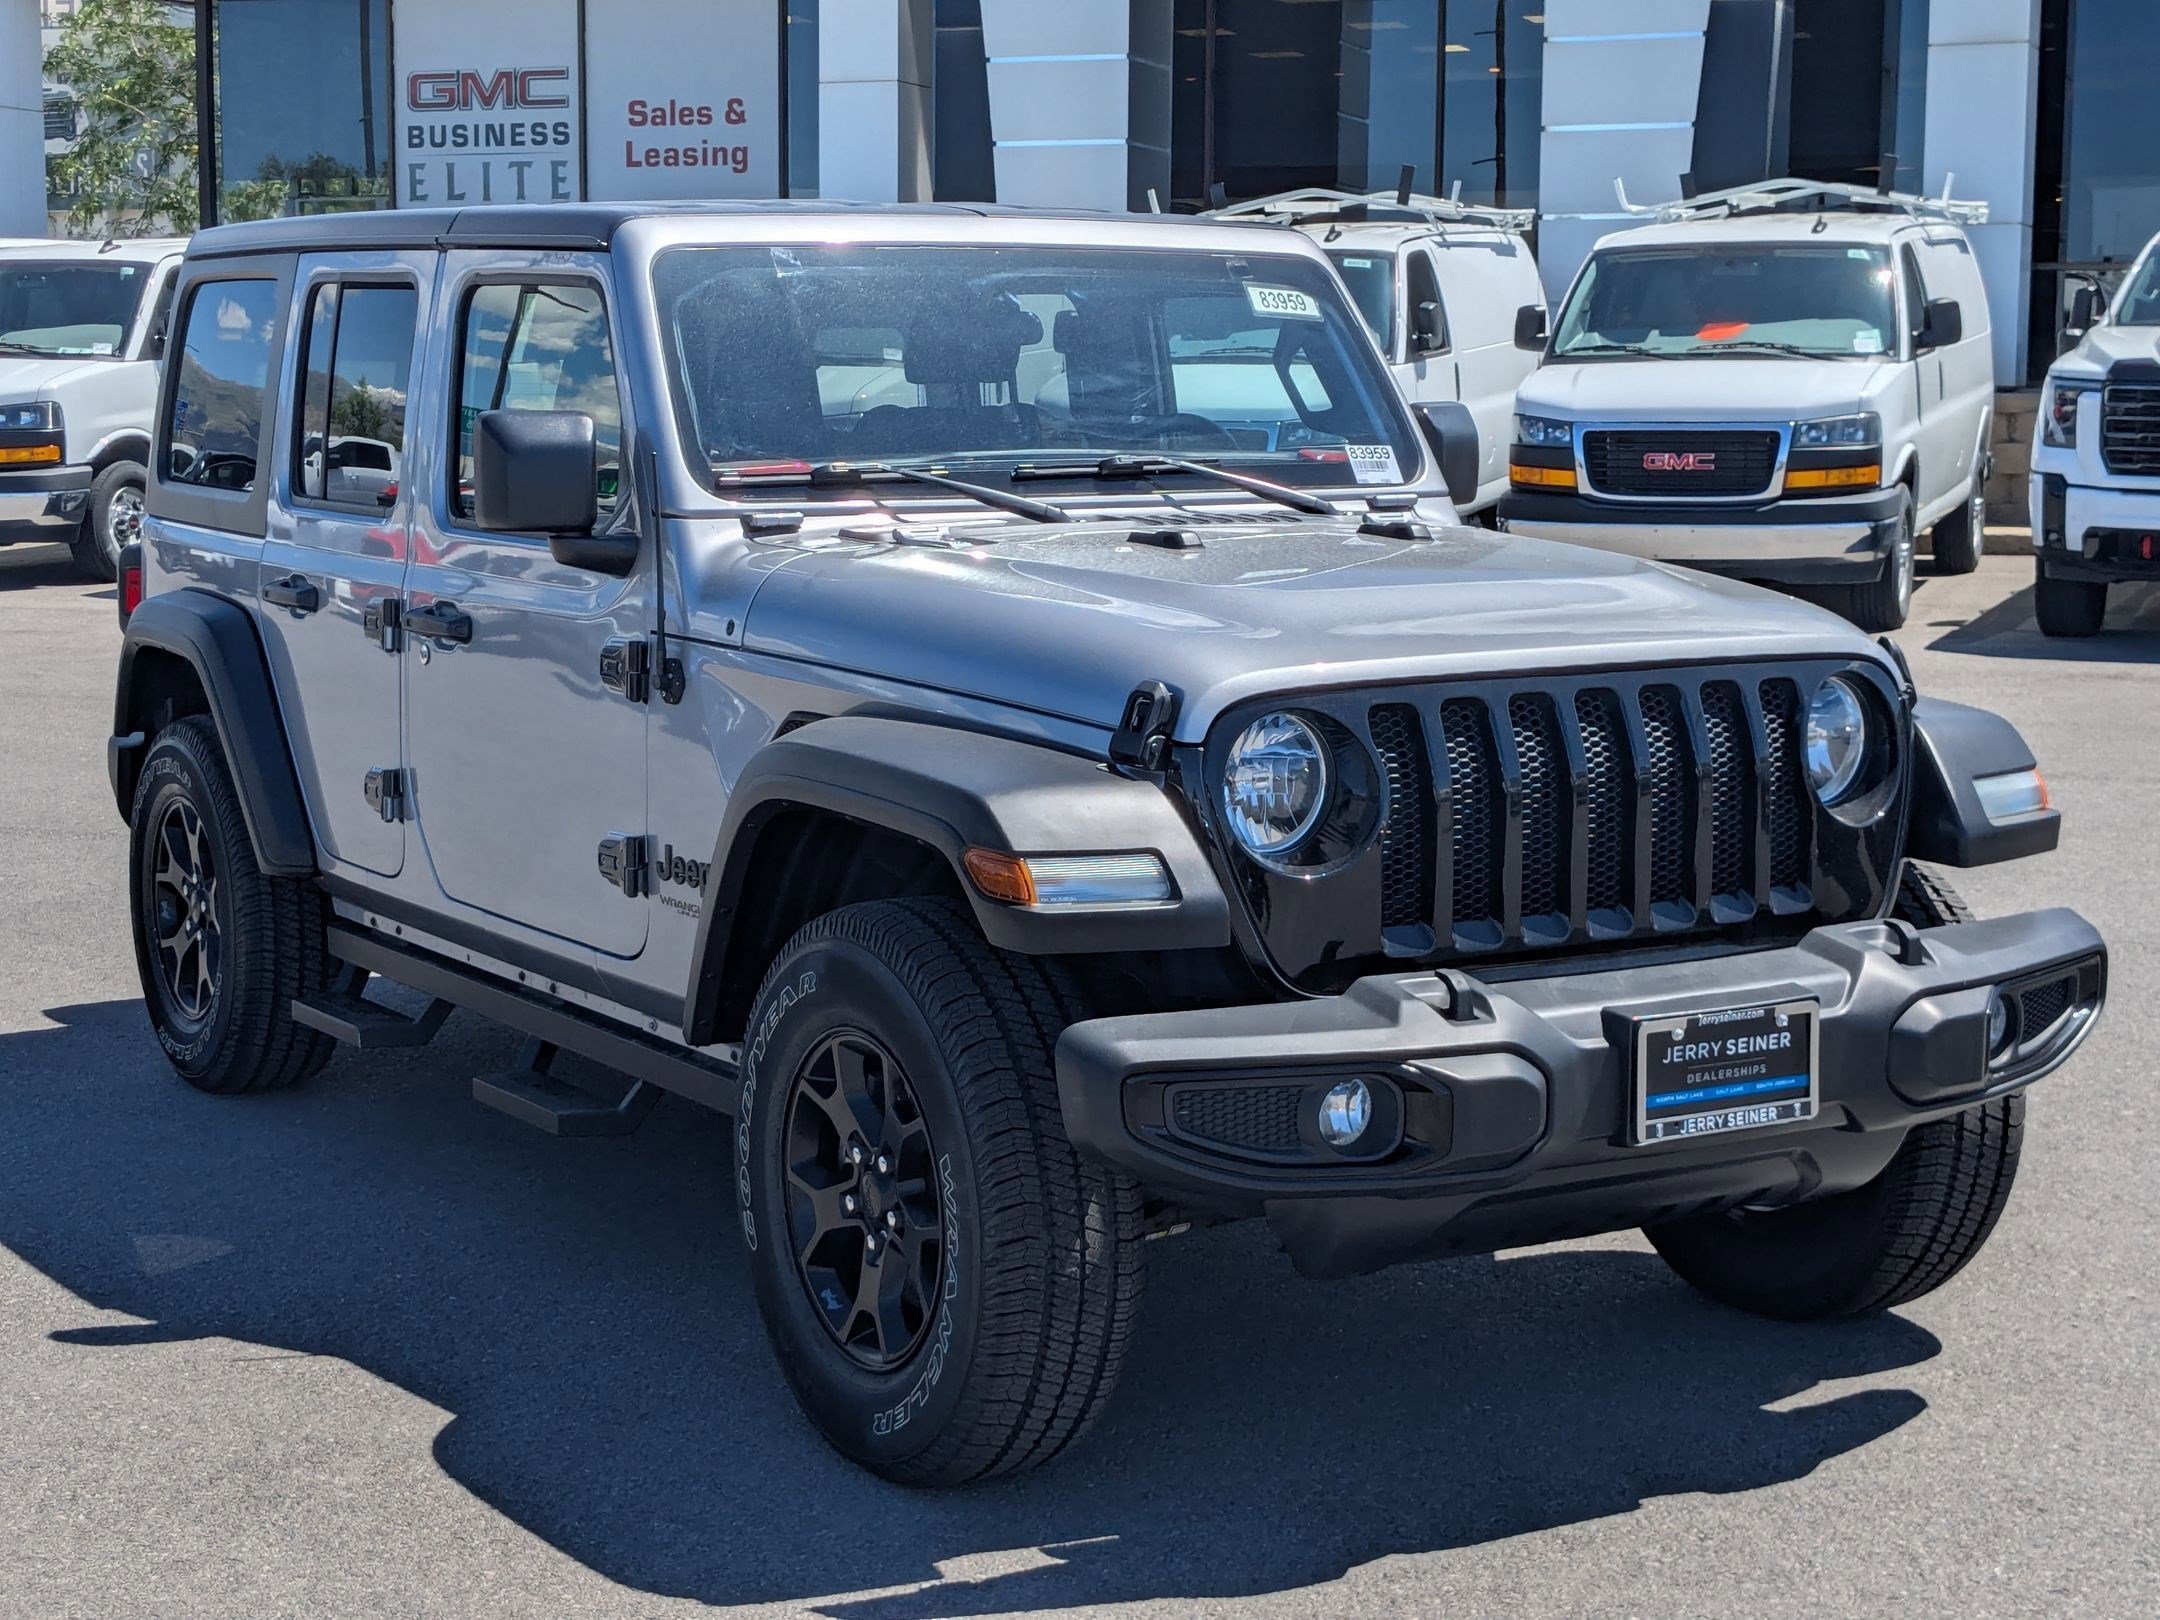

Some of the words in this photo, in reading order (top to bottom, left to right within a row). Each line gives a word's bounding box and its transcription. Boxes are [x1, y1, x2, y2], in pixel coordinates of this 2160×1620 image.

[407, 66, 570, 112] GMC
[627, 99, 713, 127] Sales
[724, 97, 747, 125] &
[407, 121, 571, 149] BUSINESS
[625, 139, 749, 174] Leasing
[408, 160, 571, 202] ELITE
[1258, 290, 1307, 312] 83959
[1348, 446, 1391, 460] 83959
[1643, 453, 1716, 470] GMC
[1662, 1040, 1723, 1065] JERRY
[1725, 1031, 1791, 1055] SEINER
[1686, 1063, 1767, 1084] DEALERSHIPS
[738, 971, 817, 1252] GOODYEAR
[1679, 1114, 1724, 1135] JERRY
[1727, 1106, 1778, 1128] SEINER
[872, 1153, 960, 1436] WRANGLER
